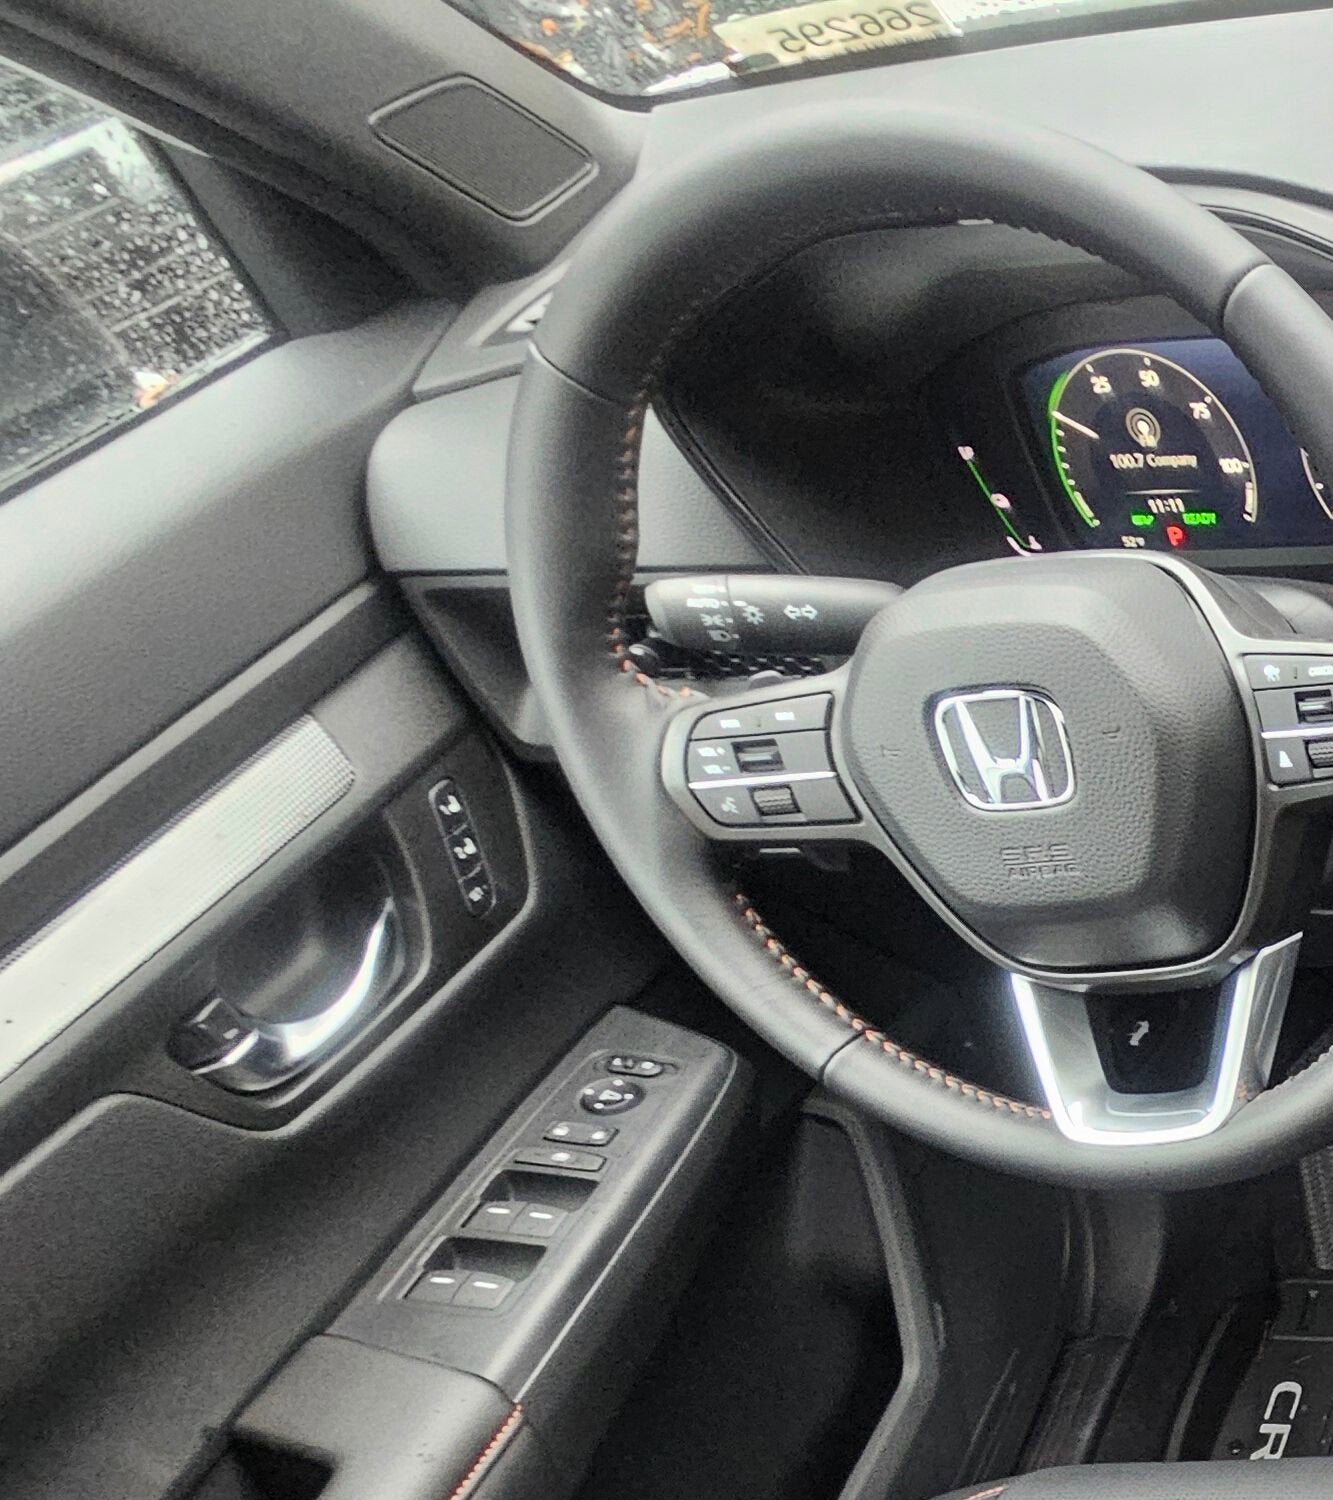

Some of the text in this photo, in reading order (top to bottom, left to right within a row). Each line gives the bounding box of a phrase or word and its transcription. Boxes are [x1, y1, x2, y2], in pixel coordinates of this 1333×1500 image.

[1090, 375, 1113, 394] 25
[1138, 369, 1161, 387] 50
[1188, 402, 1212, 420] 75
[1109, 453, 1198, 469] 100.7 Company
[1219, 457, 1244, 474] 100
[1147, 498, 1185, 514] 11:11
[1166, 526, 1185, 546] P
